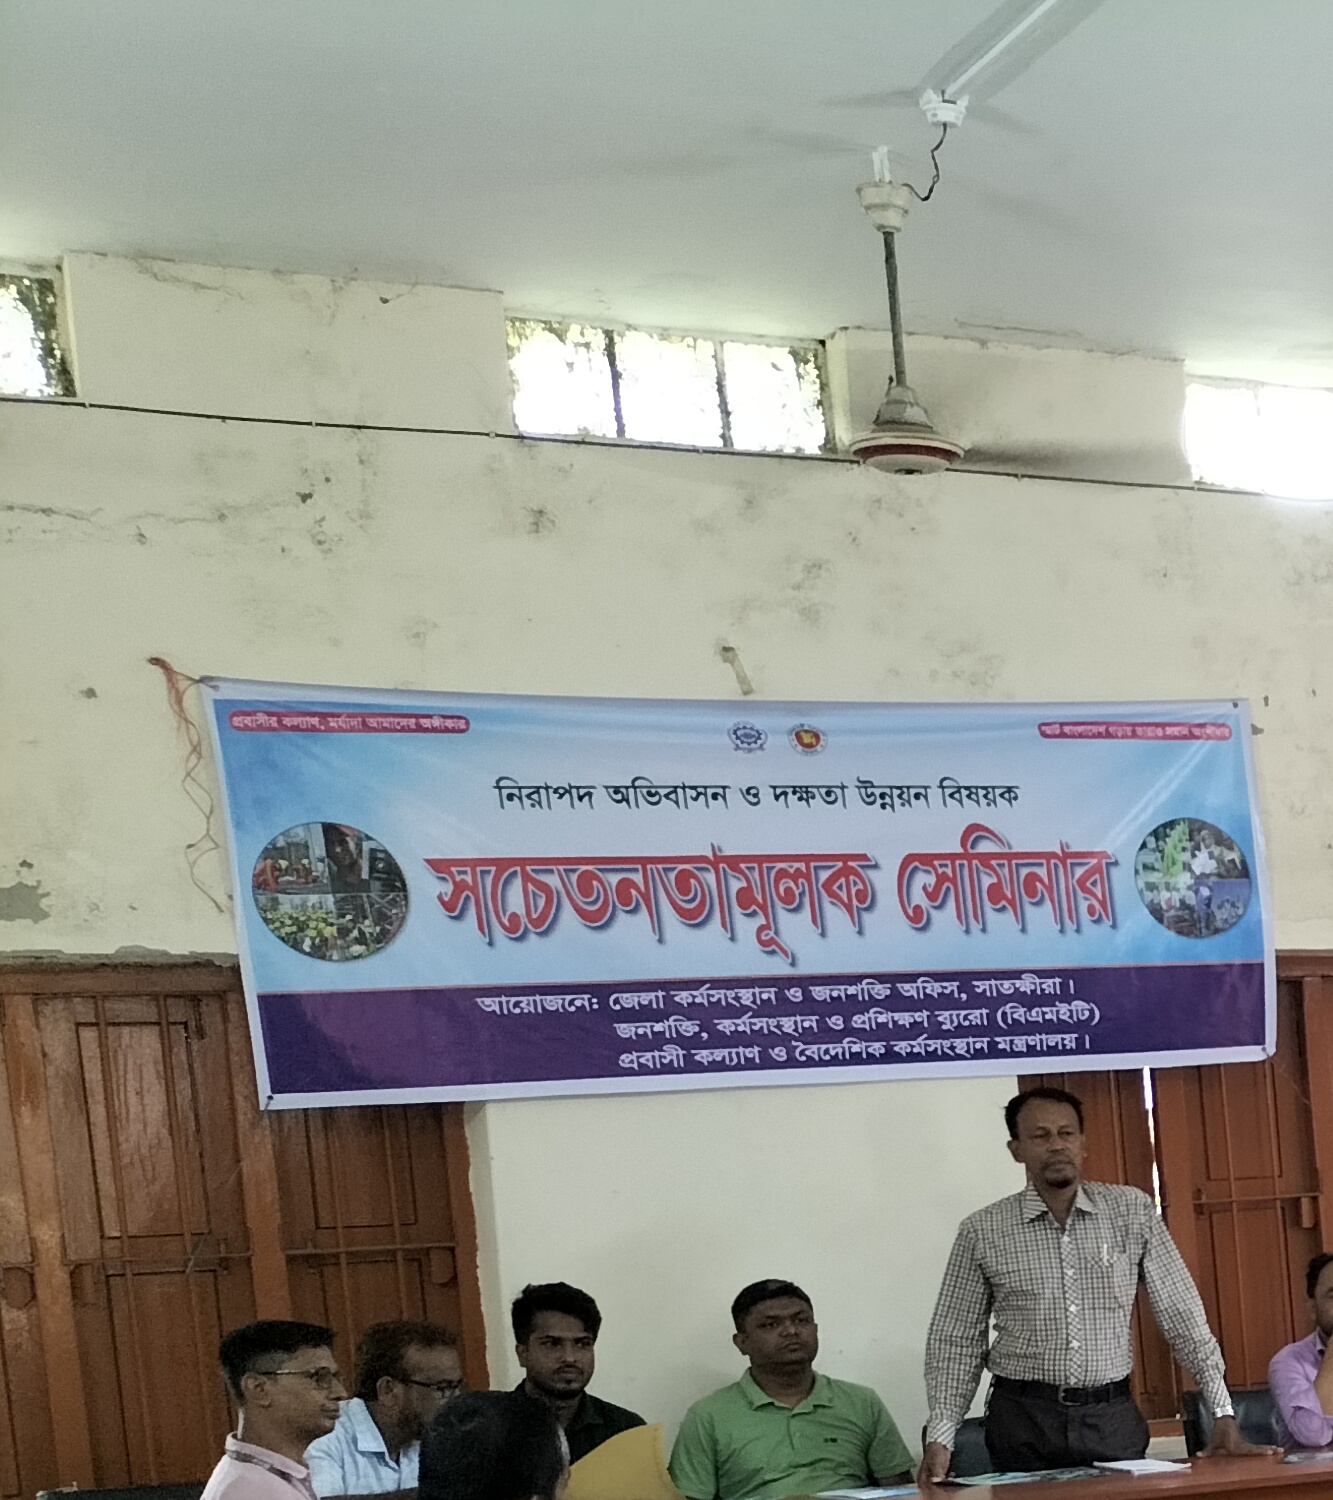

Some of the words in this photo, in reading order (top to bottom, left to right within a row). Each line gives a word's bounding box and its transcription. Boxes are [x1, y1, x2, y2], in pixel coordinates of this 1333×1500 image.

[494, 776, 597, 810] নিরাপদ
[605, 776, 731, 810] অভিবাসন
[739, 787, 761, 809] ও
[770, 782, 848, 810] দক্ষতা
[856, 777, 931, 814] উন্নয়ন
[937, 777, 1020, 809] বিষয়ক
[423, 842, 876, 964] সচেতনতামূলক
[898, 822, 1117, 932] সেমিনার
[609, 988, 665, 1011] জেলা
[670, 983, 778, 1009] কর্মসংস্থান
[785, 987, 802, 1003] ও
[809, 977, 891, 1003] জনশক্তি
[896, 976, 968, 1001] অফিস,
[614, 1015, 709, 1041] জনশক্তি,
[714, 1011, 818, 1037] কর্মসংস্থান
[826, 1014, 844, 1030] ও
[851, 1006, 929, 1030] প্রশিক্ষণ
[935, 1008, 989, 1032] ব্যুরো
[996, 1000, 1100, 1029] (বিএমইটি)
[618, 1044, 686, 1071] প্রবাসী
[692, 1044, 762, 1066] কল্যাণ
[769, 1046, 787, 1062] ও
[795, 1037, 886, 1062] বৈদেশিক
[893, 1033, 990, 1057] কর্মসংস্থান
